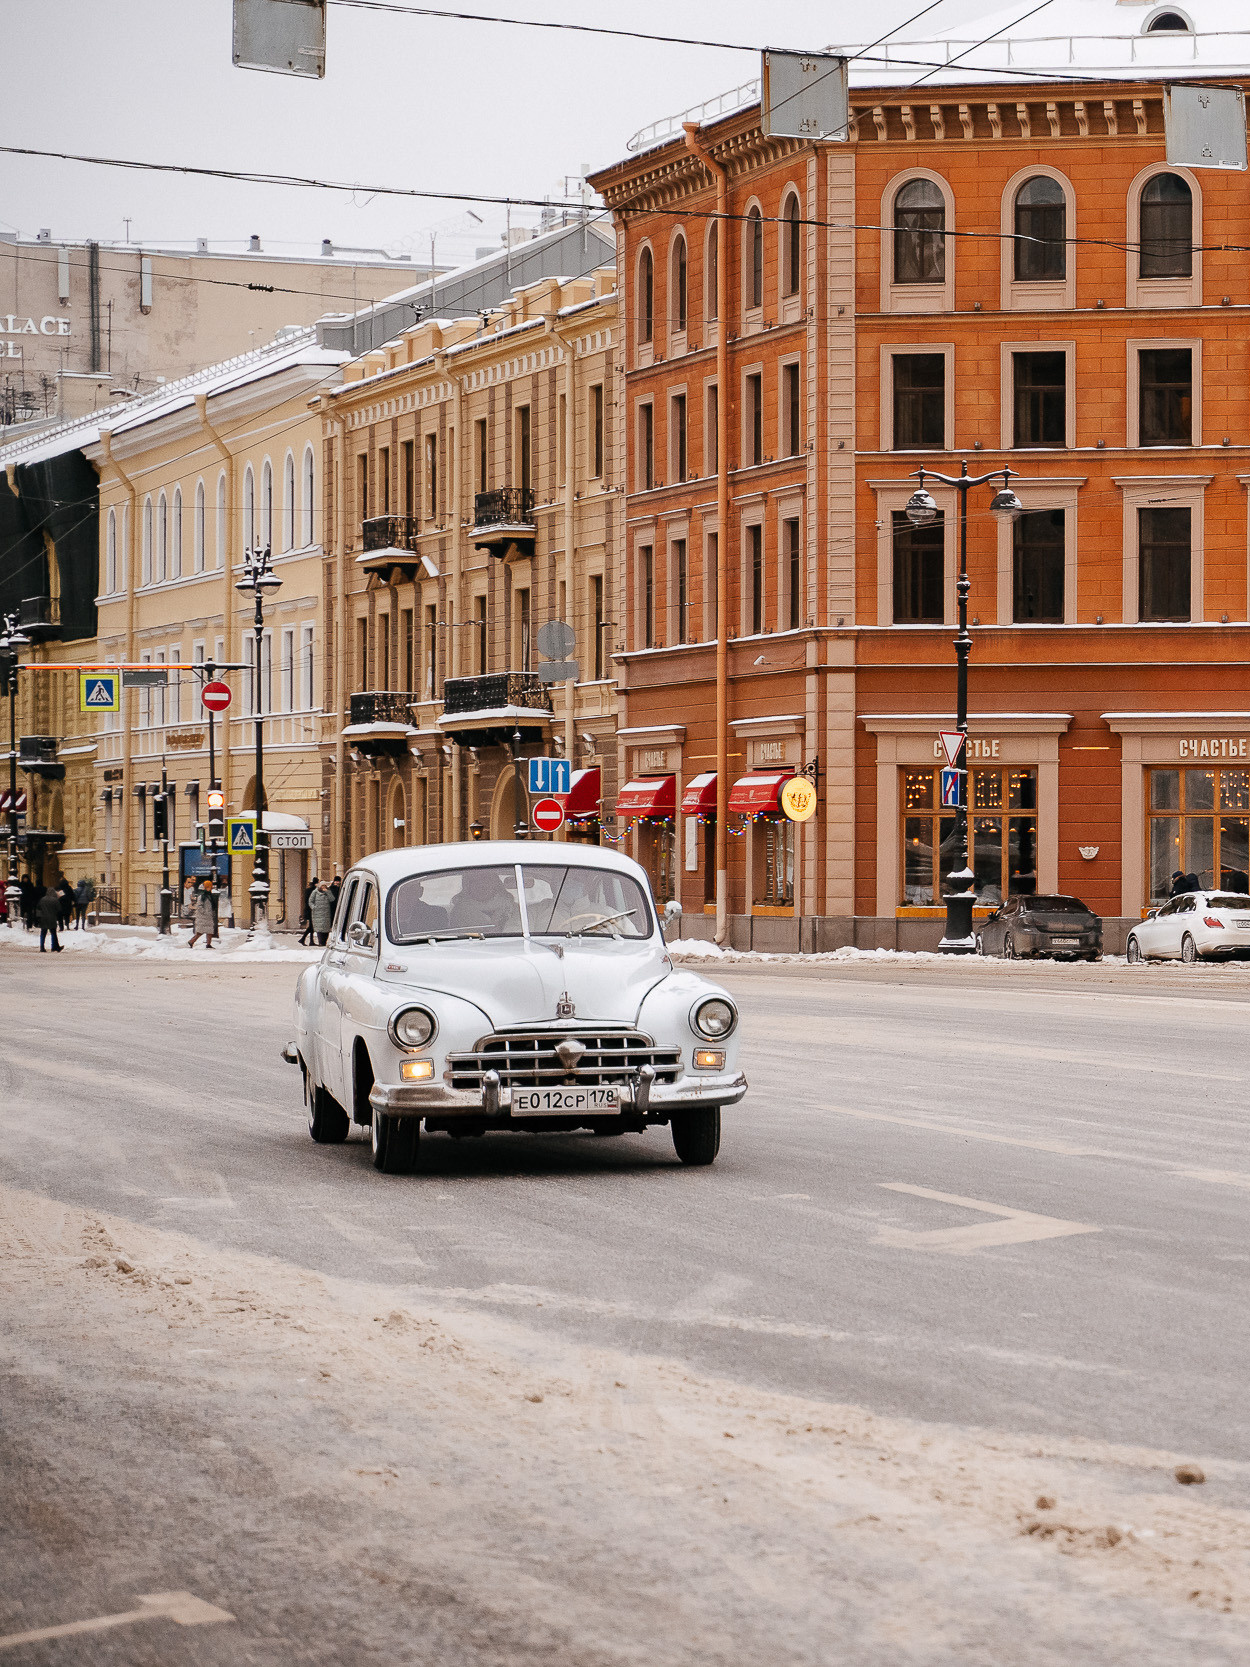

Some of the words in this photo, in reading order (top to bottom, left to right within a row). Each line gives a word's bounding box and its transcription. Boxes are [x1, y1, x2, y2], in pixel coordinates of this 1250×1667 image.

[933, 739, 1000, 758] ССТЬЕ
[1179, 738, 1248, 757] СЧАСТЬЕ
[276, 837, 307, 846] СТОП
[589, 1090, 614, 1102] 178
